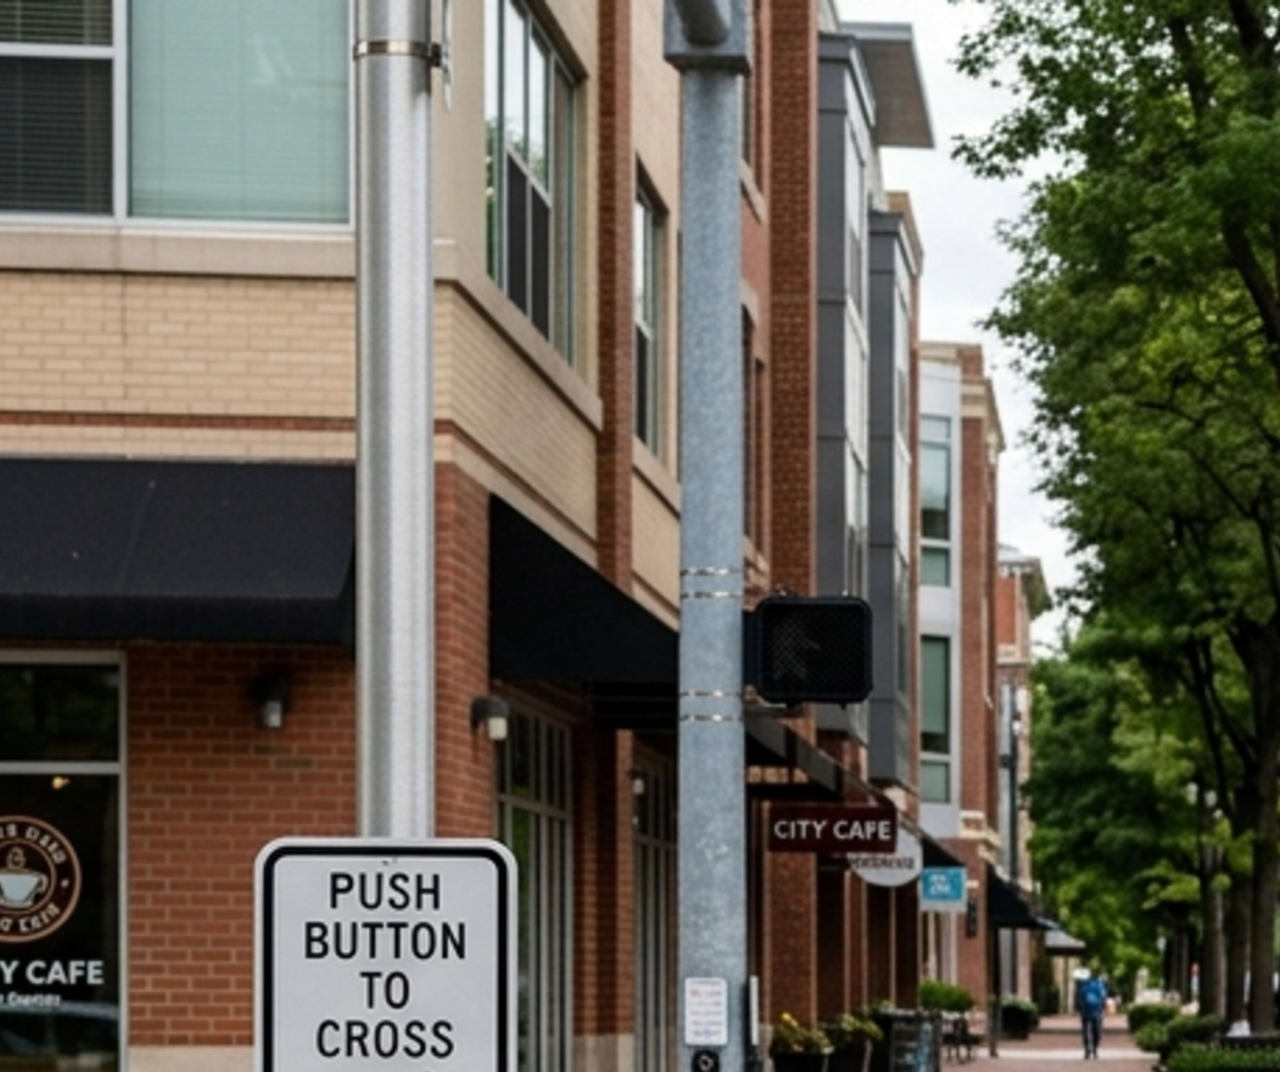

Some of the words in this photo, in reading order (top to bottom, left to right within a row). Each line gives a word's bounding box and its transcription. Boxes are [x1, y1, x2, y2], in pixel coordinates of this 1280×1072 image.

[773, 820, 828, 840] CITY
[833, 820, 892, 842] CAFE
[330, 872, 440, 910] PUSH
[304, 921, 466, 960] BUTTON
[25, 959, 105, 986] CAFE
[360, 971, 410, 1009] TO
[316, 1020, 454, 1058] CROSS
